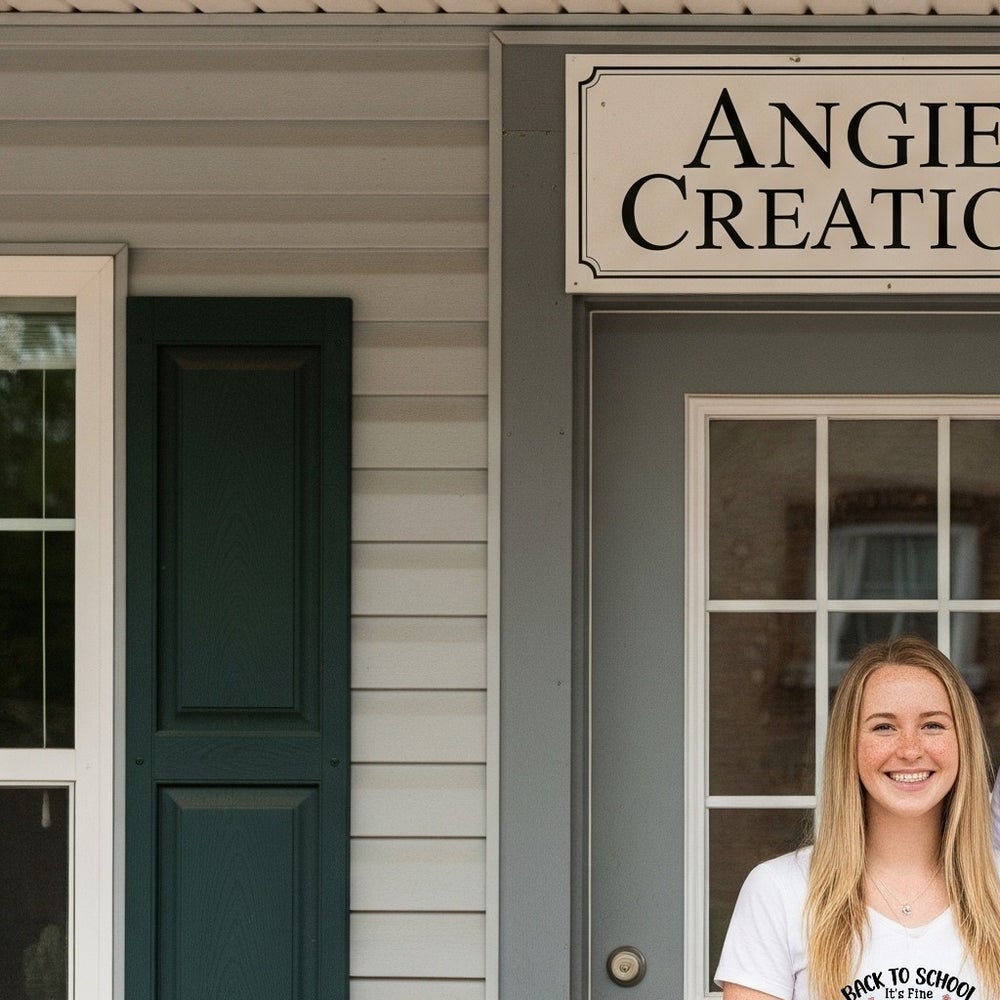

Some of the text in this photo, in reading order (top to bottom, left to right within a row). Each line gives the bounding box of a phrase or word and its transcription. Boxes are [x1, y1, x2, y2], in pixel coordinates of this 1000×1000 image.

[888, 967, 910, 986] TO
[885, 987, 934, 1000] It's Fine
